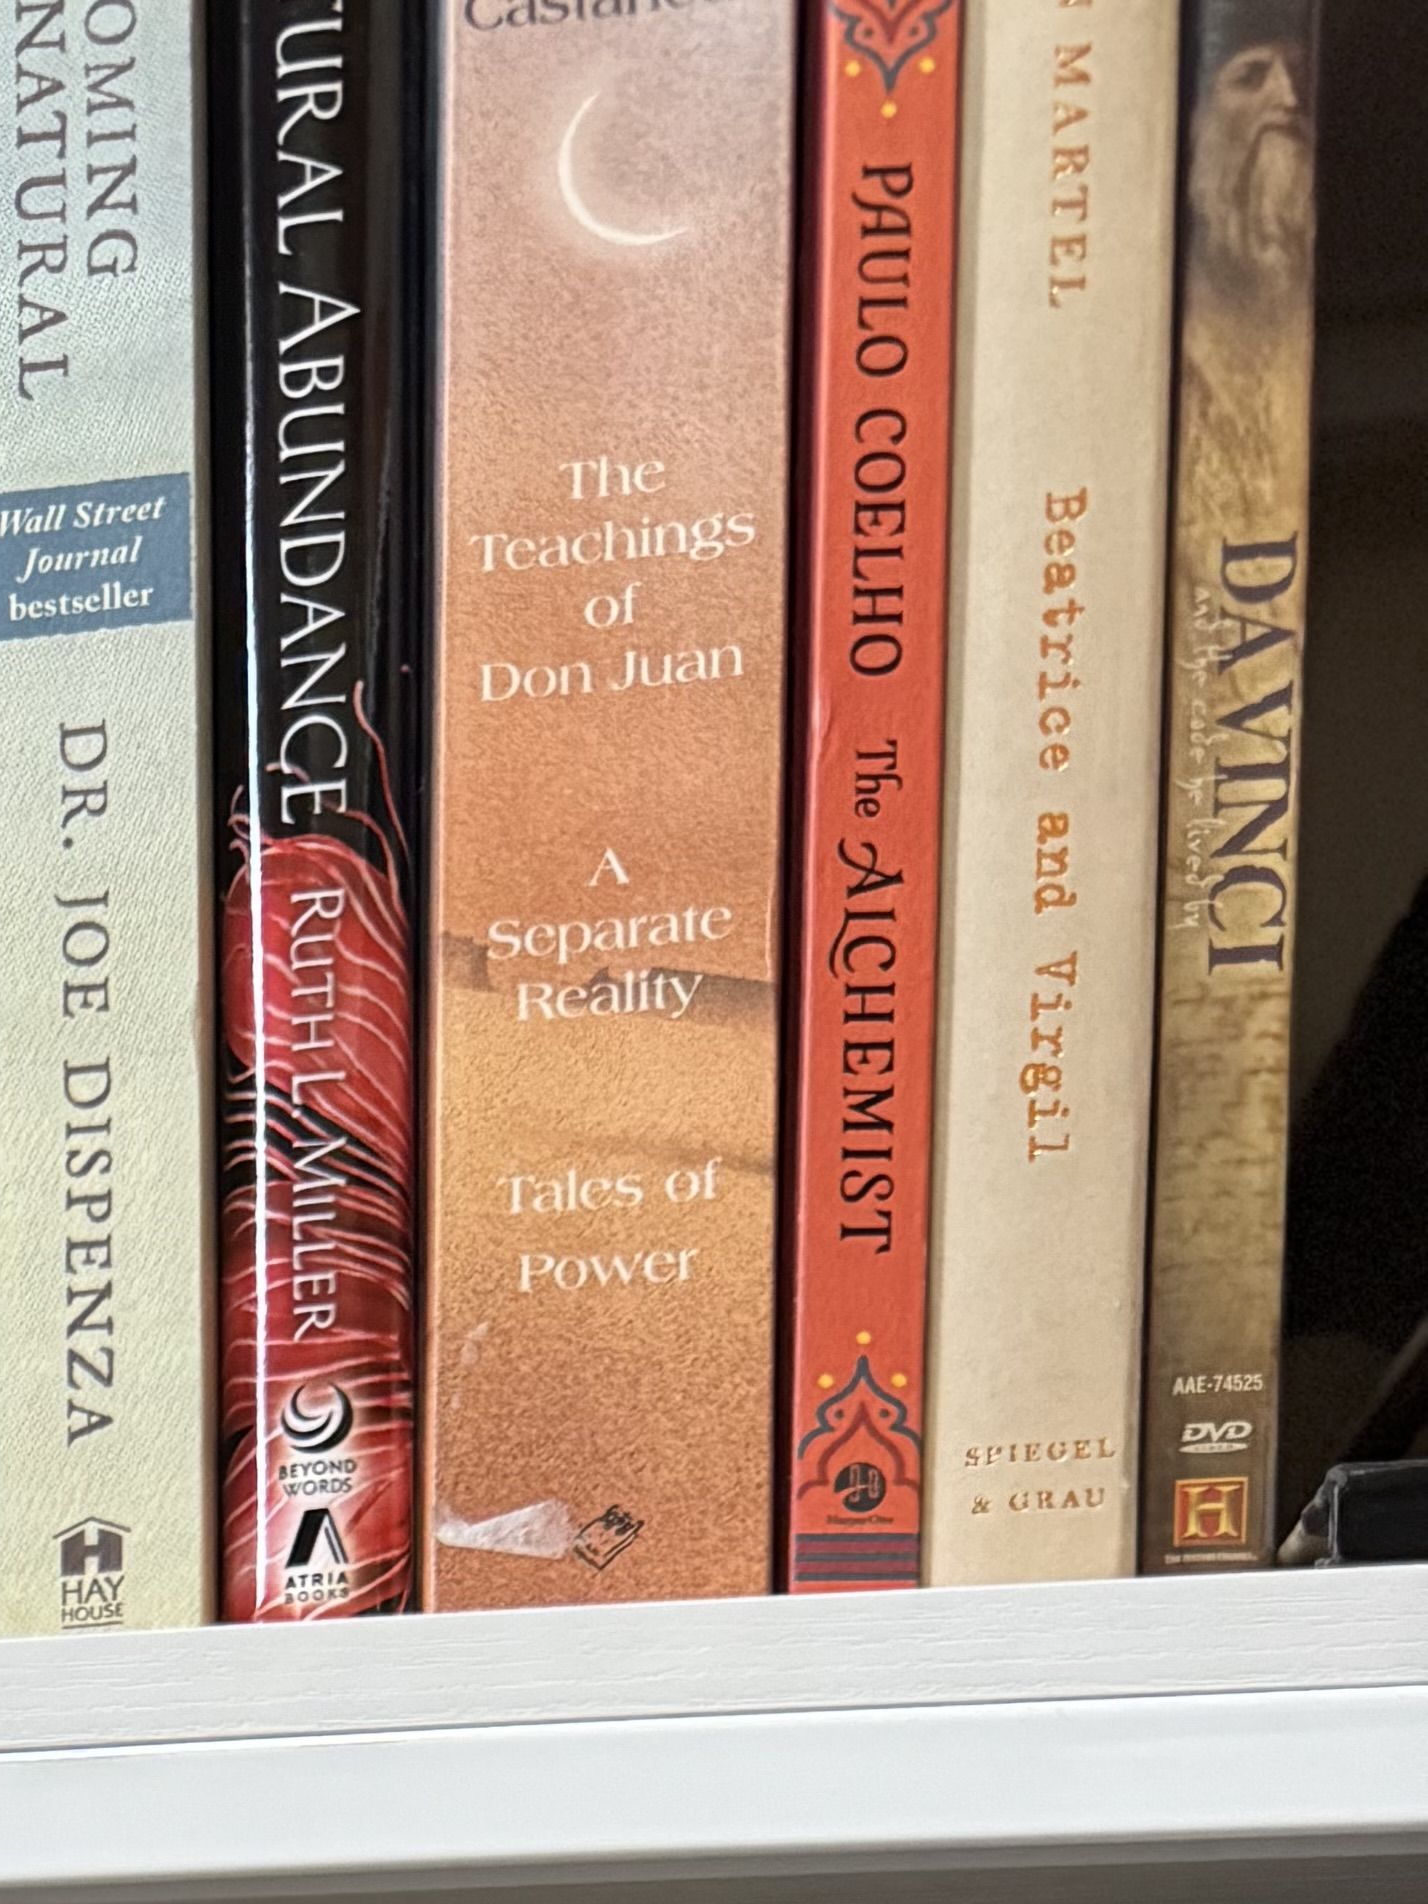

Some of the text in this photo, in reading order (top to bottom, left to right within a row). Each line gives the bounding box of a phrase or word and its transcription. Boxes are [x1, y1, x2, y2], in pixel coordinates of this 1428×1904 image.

[1048, 42, 1092, 308] MARTEL
[848, 161, 913, 679] PAULO COELHO
[559, 454, 666, 500] The
[0, 496, 166, 538] Wall Street
[16, 535, 143, 584] Journal
[275, 285, 361, 825] ABUNDANCE
[468, 512, 757, 573] Teachings
[8, 581, 154, 621] bestseller
[583, 581, 641, 628] of
[480, 643, 744, 702] Don Juan
[1019, 487, 1089, 1166] Beatrice and Virgil
[587, 847, 630, 887] A
[487, 905, 734, 965] Separate
[516, 971, 704, 1022] Reality
[828, 737, 905, 1257] The ALCHEMIST
[54, 718, 115, 1447] DR. JOE DISPENZA
[287, 886, 347, 1342] RUTH L. MILLER
[497, 1157, 723, 1215] Tales of
[519, 1248, 698, 1293] Power
[1172, 1373, 1263, 1397] AAE-74525
[964, 1436, 1116, 1467] SPIEGEL
[1181, 1421, 1253, 1443] DVD
[279, 1459, 358, 1480] BEYOND
[283, 1478, 353, 1498] WORDS
[971, 1487, 1105, 1515] & GRAU
[61, 1576, 125, 1606] HAY
[285, 1587, 349, 1604] BOOKS
[286, 1571, 349, 1589] ATRIA
[61, 1602, 124, 1622] HOUSE
